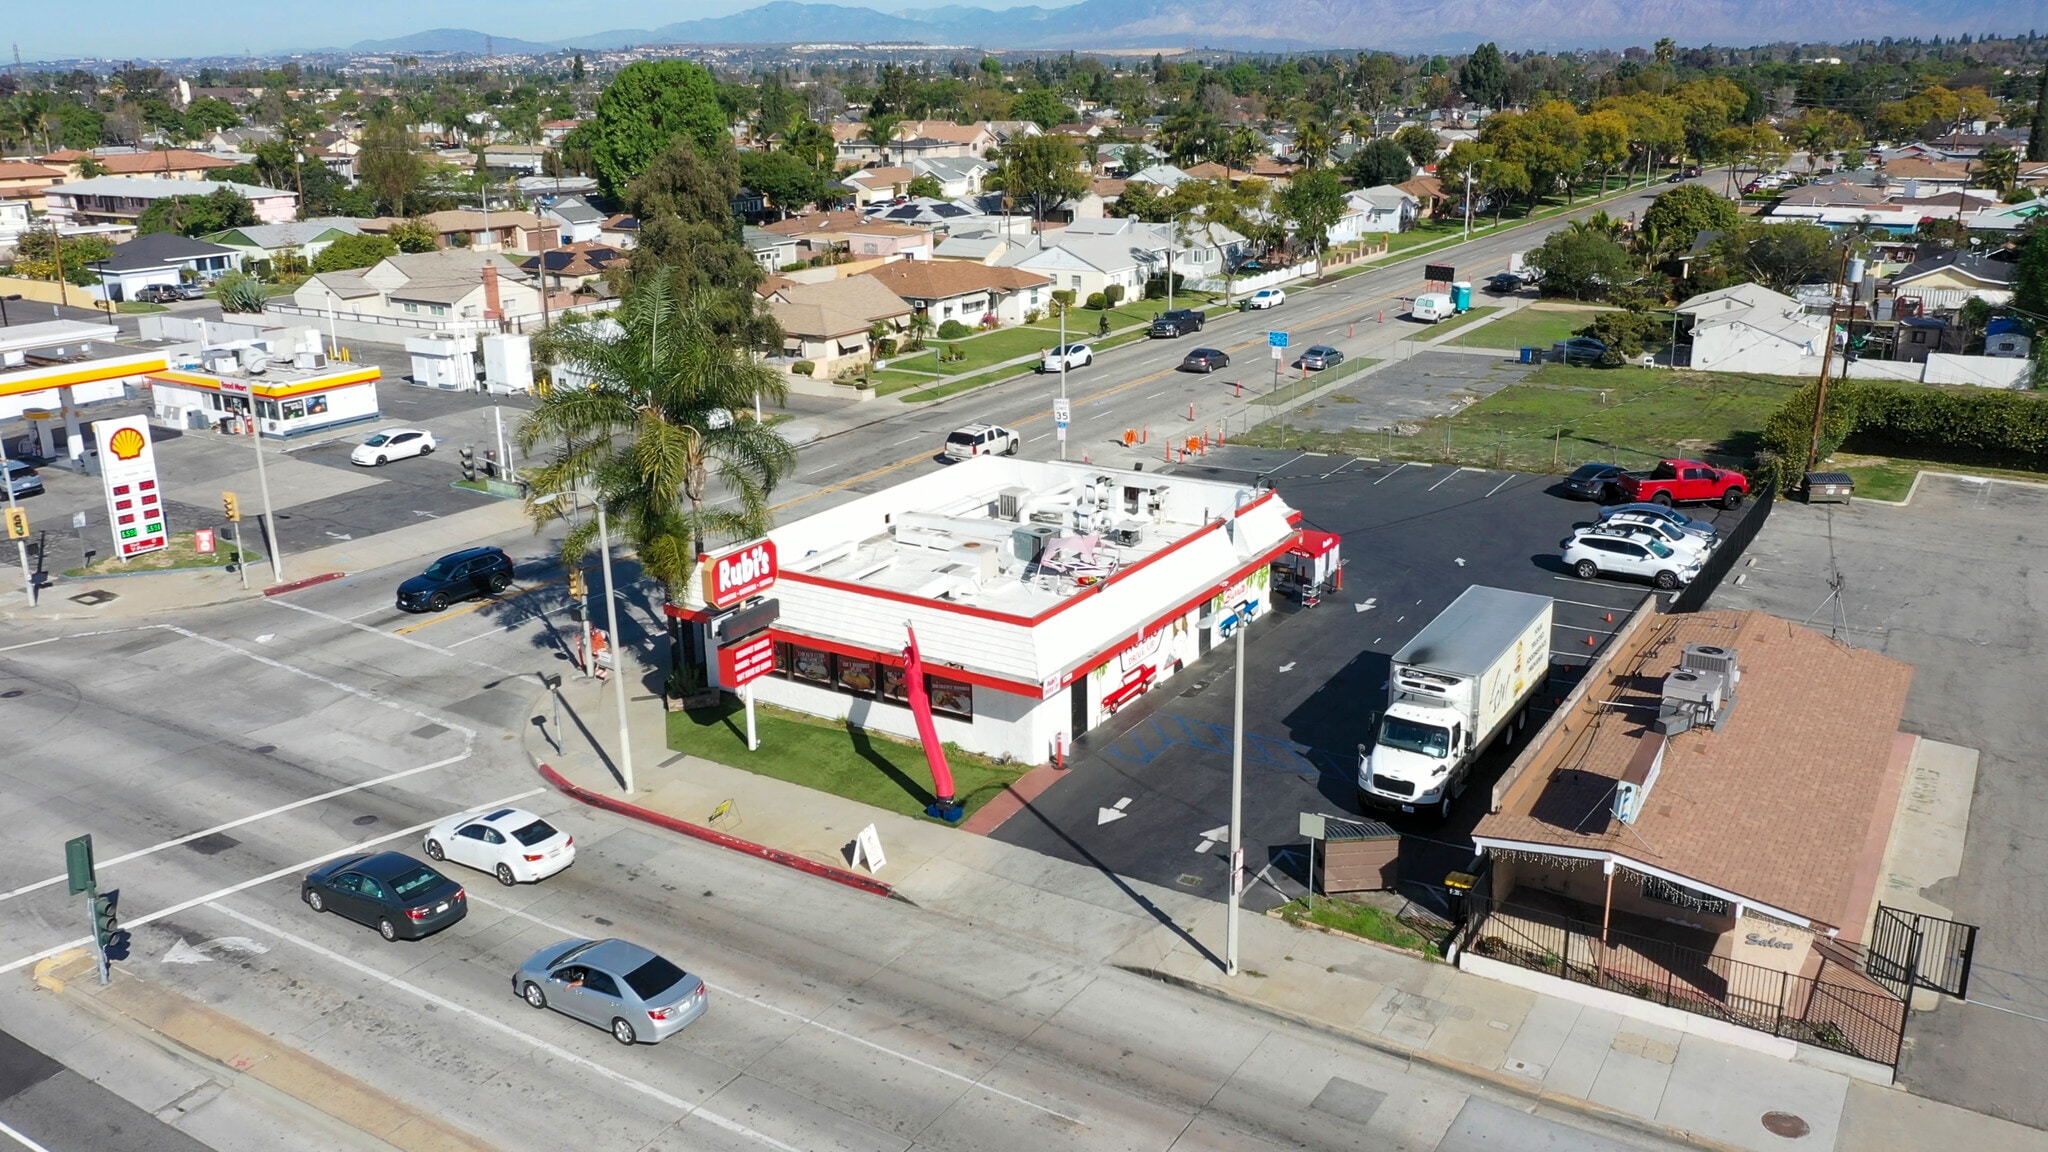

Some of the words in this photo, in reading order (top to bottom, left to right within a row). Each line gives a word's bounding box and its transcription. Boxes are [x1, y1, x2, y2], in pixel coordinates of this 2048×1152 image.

[221, 381, 234, 389] Food
[234, 383, 247, 391] Mart
[1056, 411, 1068, 420] 35
[719, 545, 770, 592] Rubi's
[1744, 933, 1794, 950] Salon
